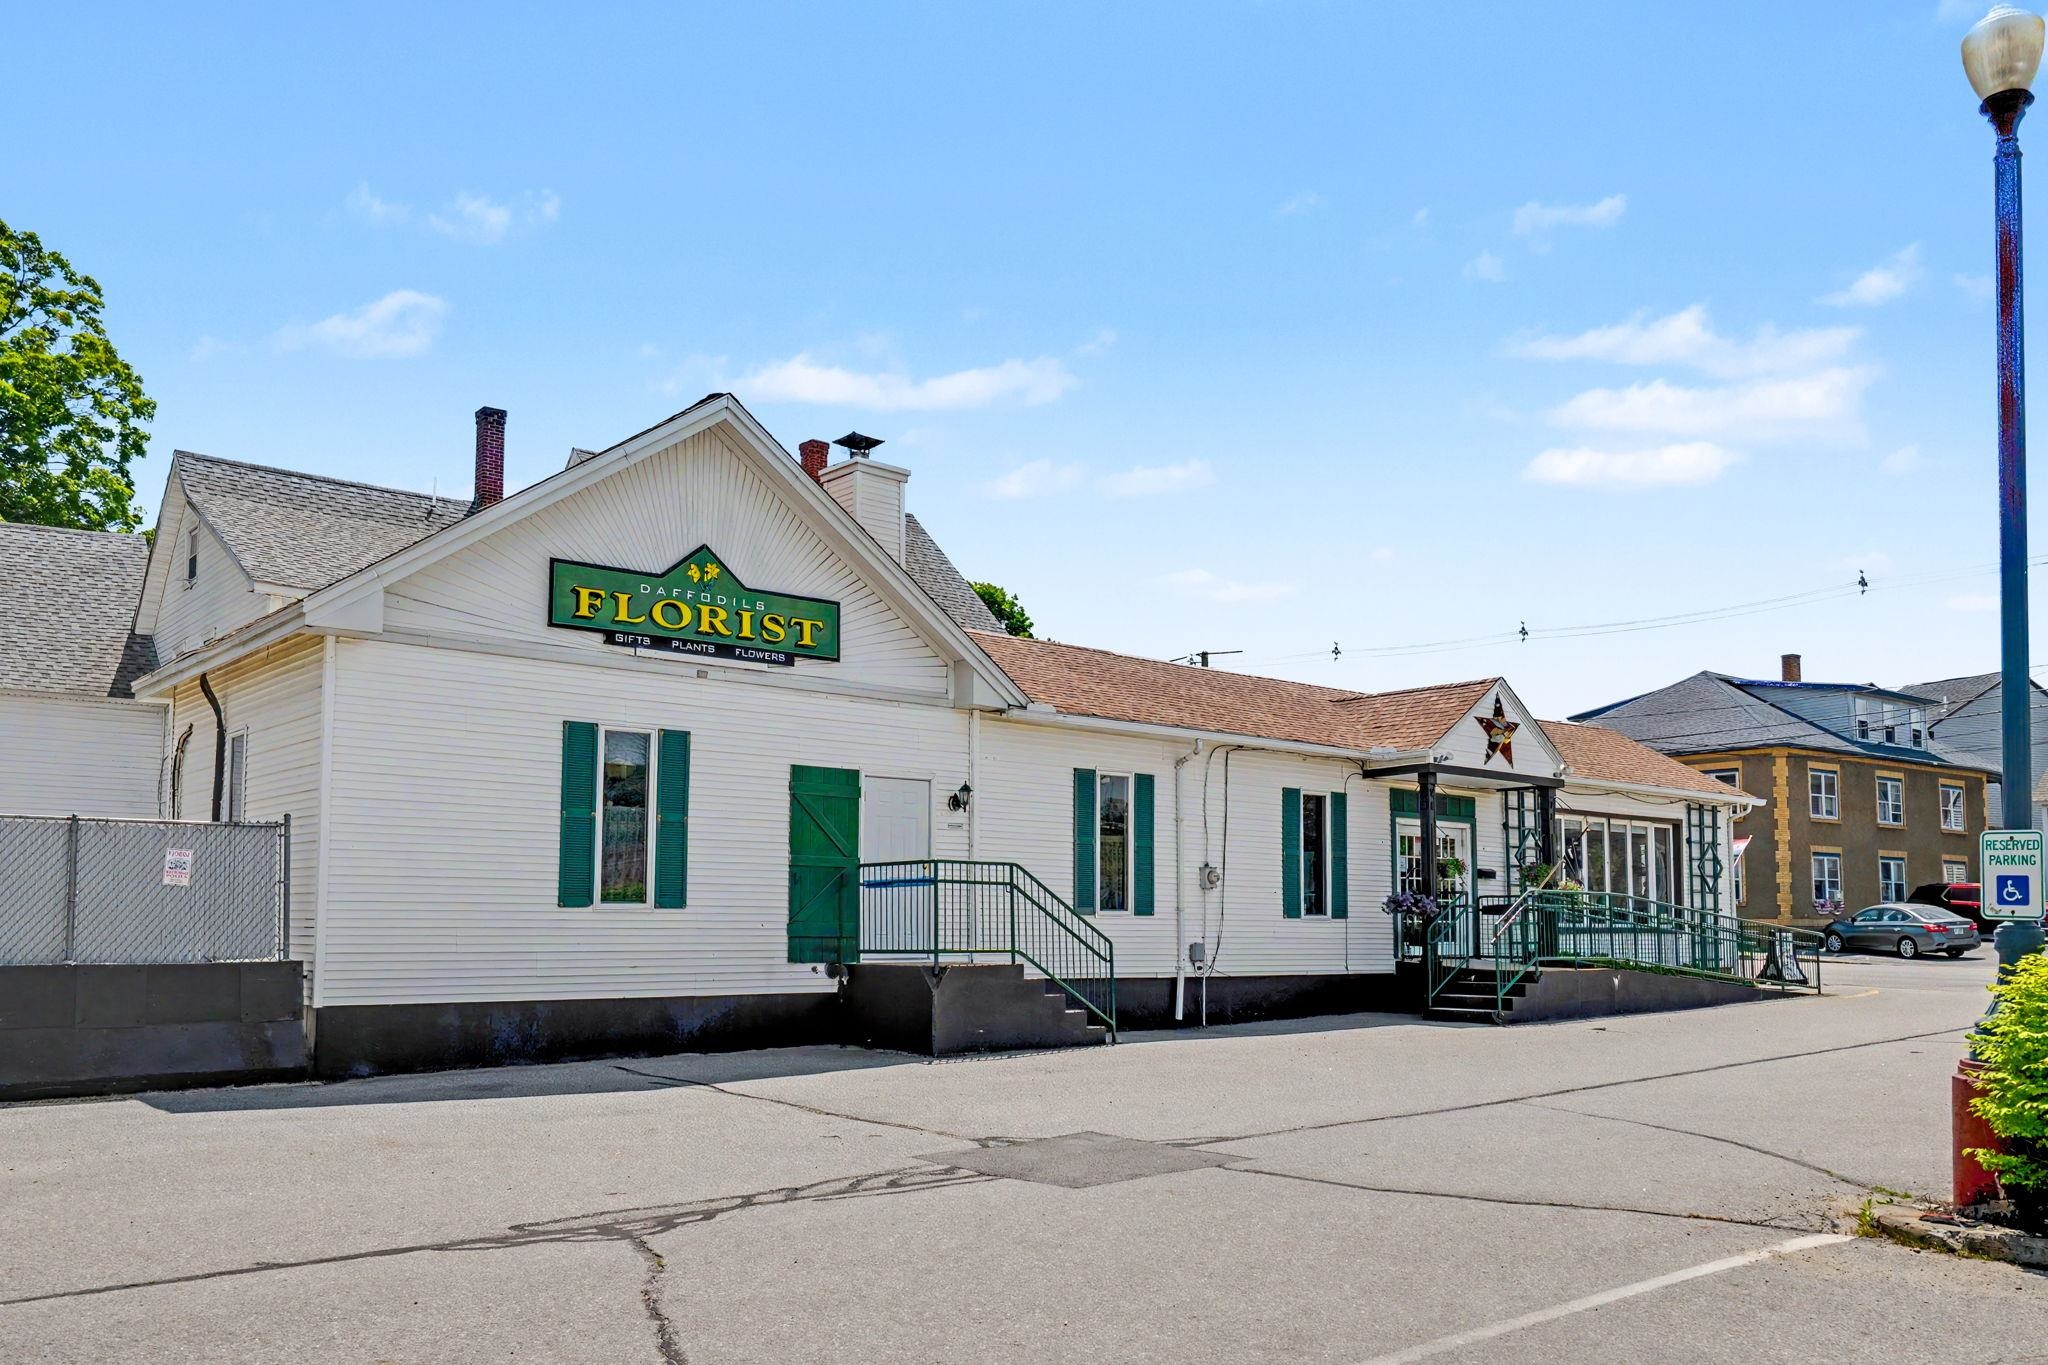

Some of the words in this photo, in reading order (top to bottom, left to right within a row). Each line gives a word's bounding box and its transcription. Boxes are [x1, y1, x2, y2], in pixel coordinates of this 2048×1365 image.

[640, 583, 766, 611] DAFFODILS
[572, 585, 825, 648] FLORIST
[615, 633, 651, 646] GIFTS
[671, 640, 716, 653] PLANTS
[735, 648, 786, 662] FLOWERS
[1985, 839, 2040, 851] RESERVED
[1989, 854, 2037, 866] PARKING
